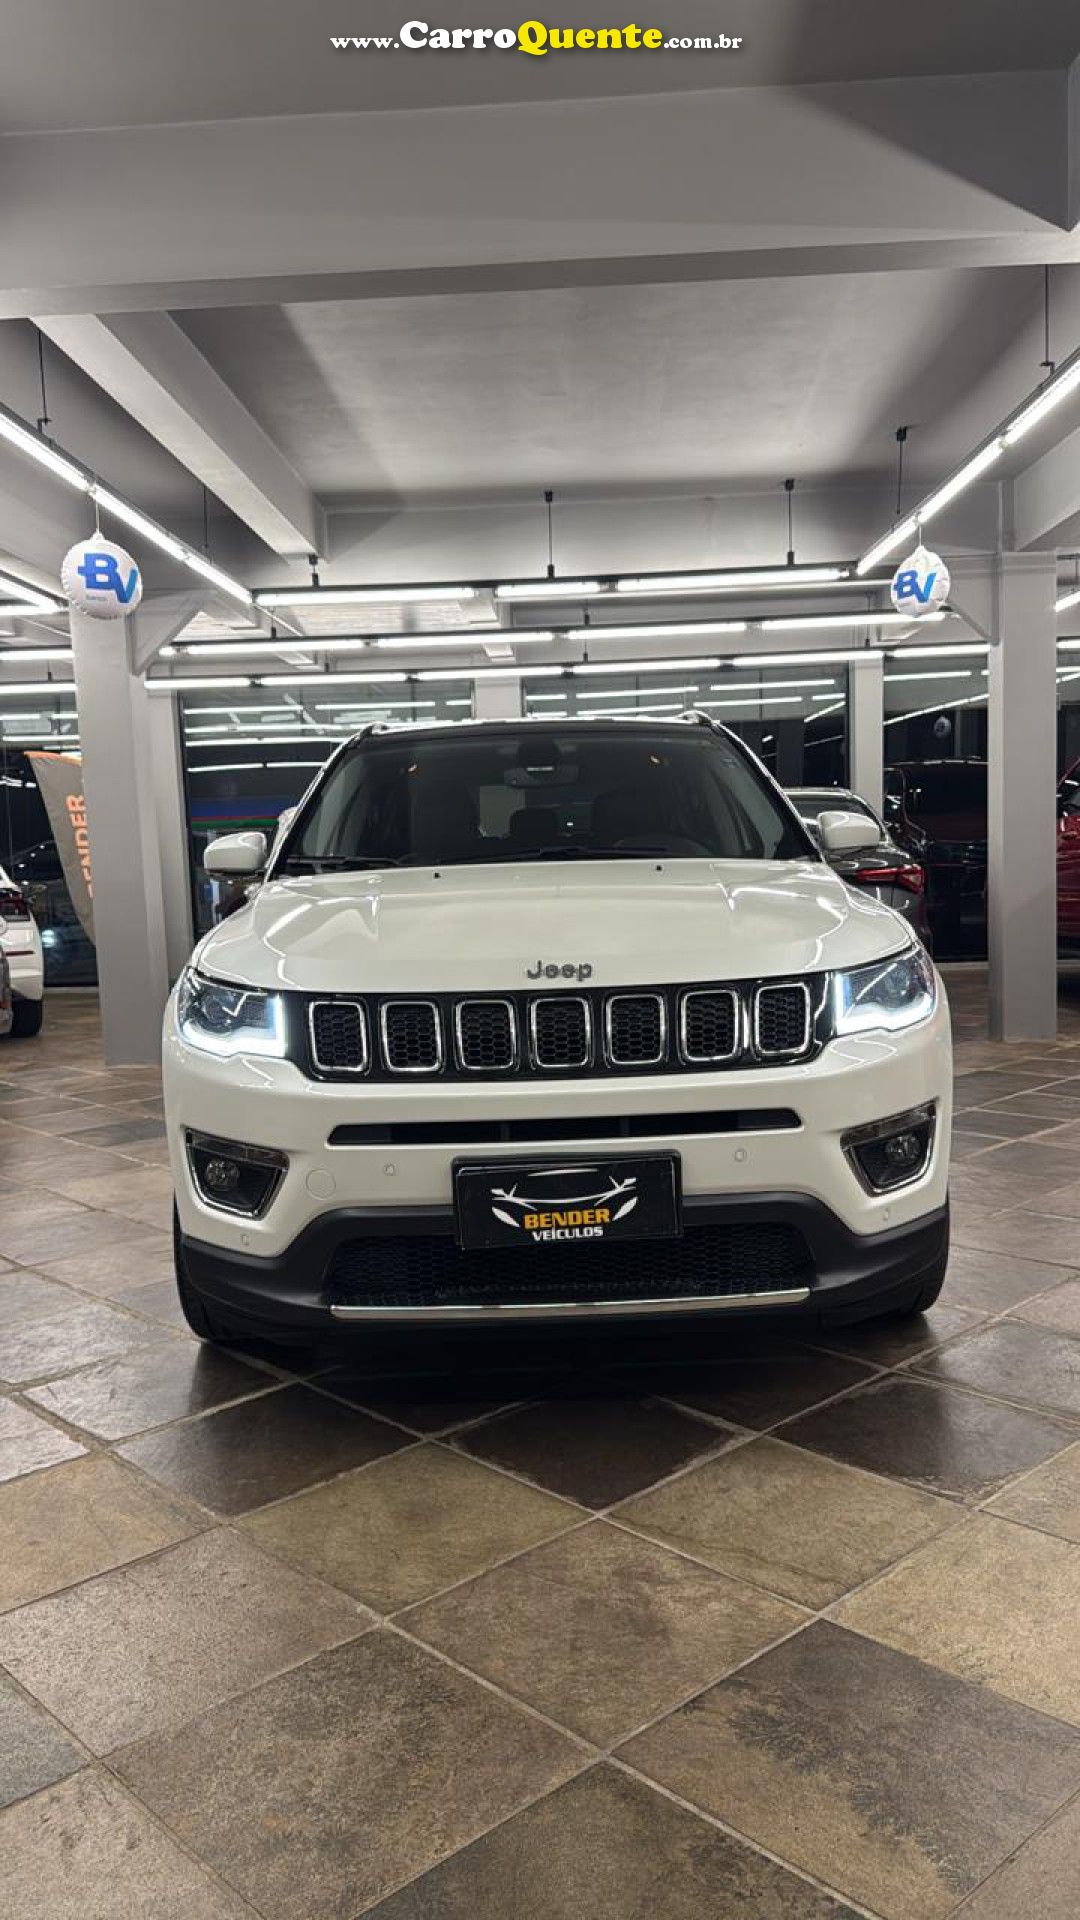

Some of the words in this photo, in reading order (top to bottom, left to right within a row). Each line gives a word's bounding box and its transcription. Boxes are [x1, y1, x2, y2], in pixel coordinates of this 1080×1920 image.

[77, 552, 138, 604] BV
[893, 569, 937, 603] BV
[65, 793, 93, 899] NDER
[527, 959, 592, 982] Jeep
[524, 1209, 610, 1229] BENDER
[532, 1226, 604, 1241] VEÍCULOS
